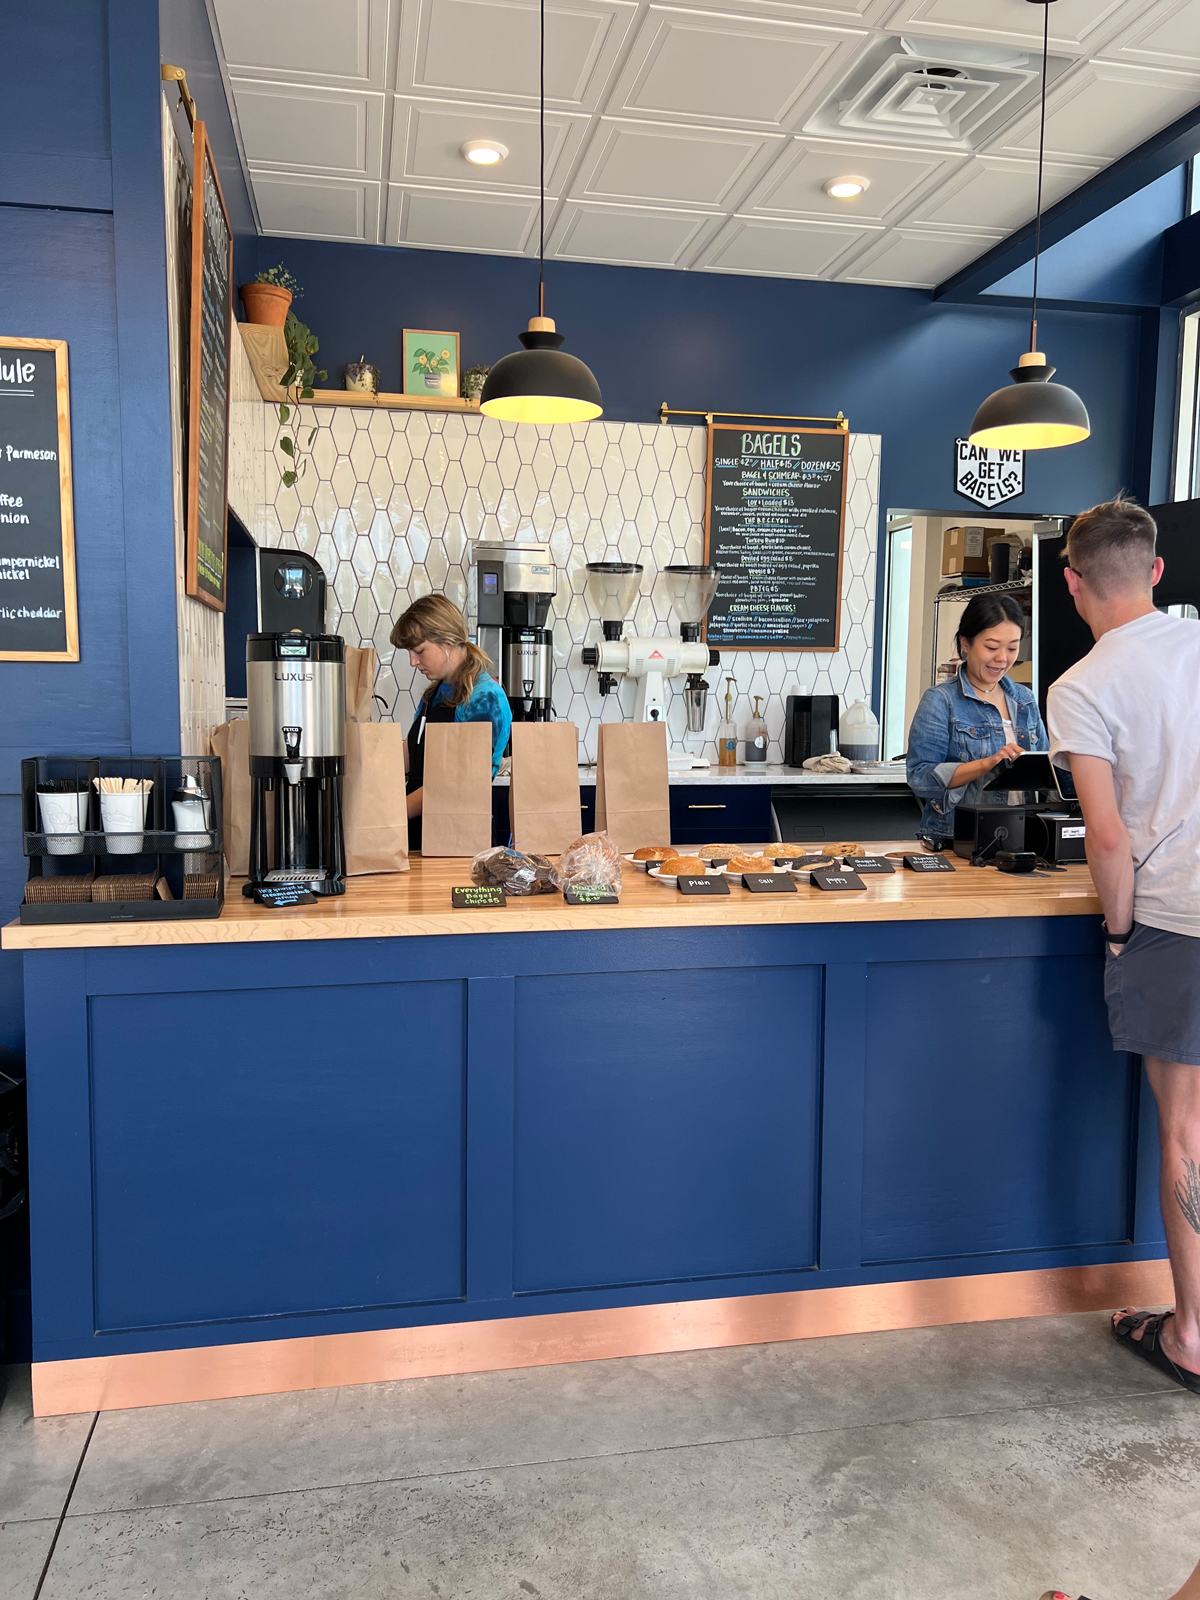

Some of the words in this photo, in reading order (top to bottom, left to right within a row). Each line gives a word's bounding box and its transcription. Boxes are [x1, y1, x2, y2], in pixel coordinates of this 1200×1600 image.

[741, 432, 802, 457] BAGELS
[959, 443, 988, 461] CAN
[998, 449, 1021, 463] WE
[714, 457, 740, 466] SINGLE
[760, 459, 779, 469] HALF
[779, 460, 793, 469] $15
[801, 461, 826, 471] DOZEN
[826, 461, 841, 472] $25
[978, 461, 1005, 480] GET
[741, 471, 761, 480] BAGEL
[768, 471, 801, 481] SCHMEAR
[959, 470, 1022, 501] BAGELS?
[742, 487, 790, 497] SANDWICHES
[744, 537, 764, 545] Turkey
[760, 555, 770, 563] egg
[17, 606, 63, 619] cheddar
[729, 604, 749, 612] CREAM
[749, 604, 770, 613] CHEESE
[275, 672, 314, 682] LUXUS
[454, 887, 502, 895] Everything
